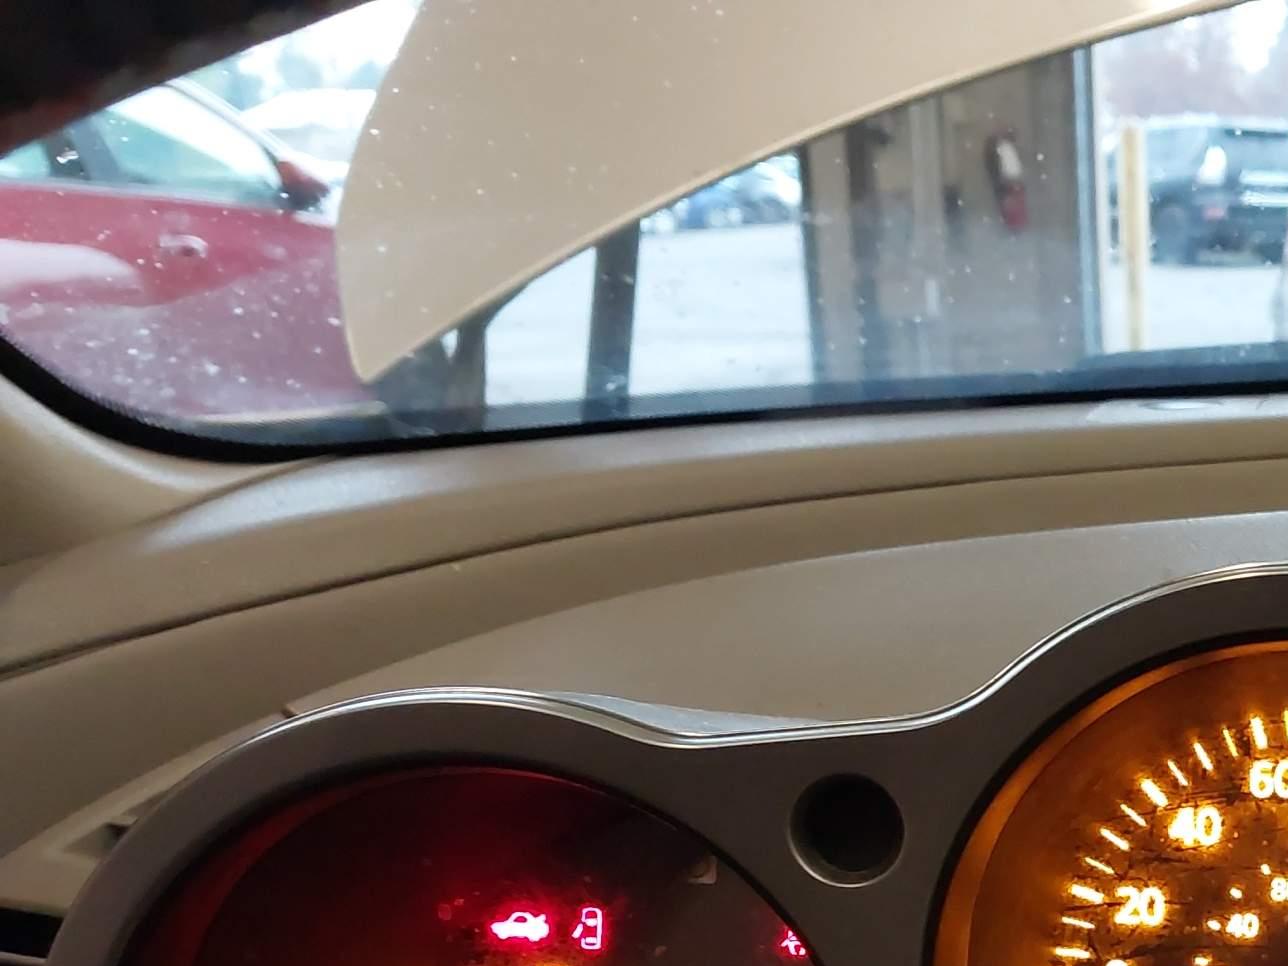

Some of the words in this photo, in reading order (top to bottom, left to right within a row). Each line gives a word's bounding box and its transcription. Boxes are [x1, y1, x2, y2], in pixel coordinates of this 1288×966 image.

[1167, 806, 1223, 847] 40
[1113, 885, 1167, 927] 20
[1225, 912, 1260, 939] 40
